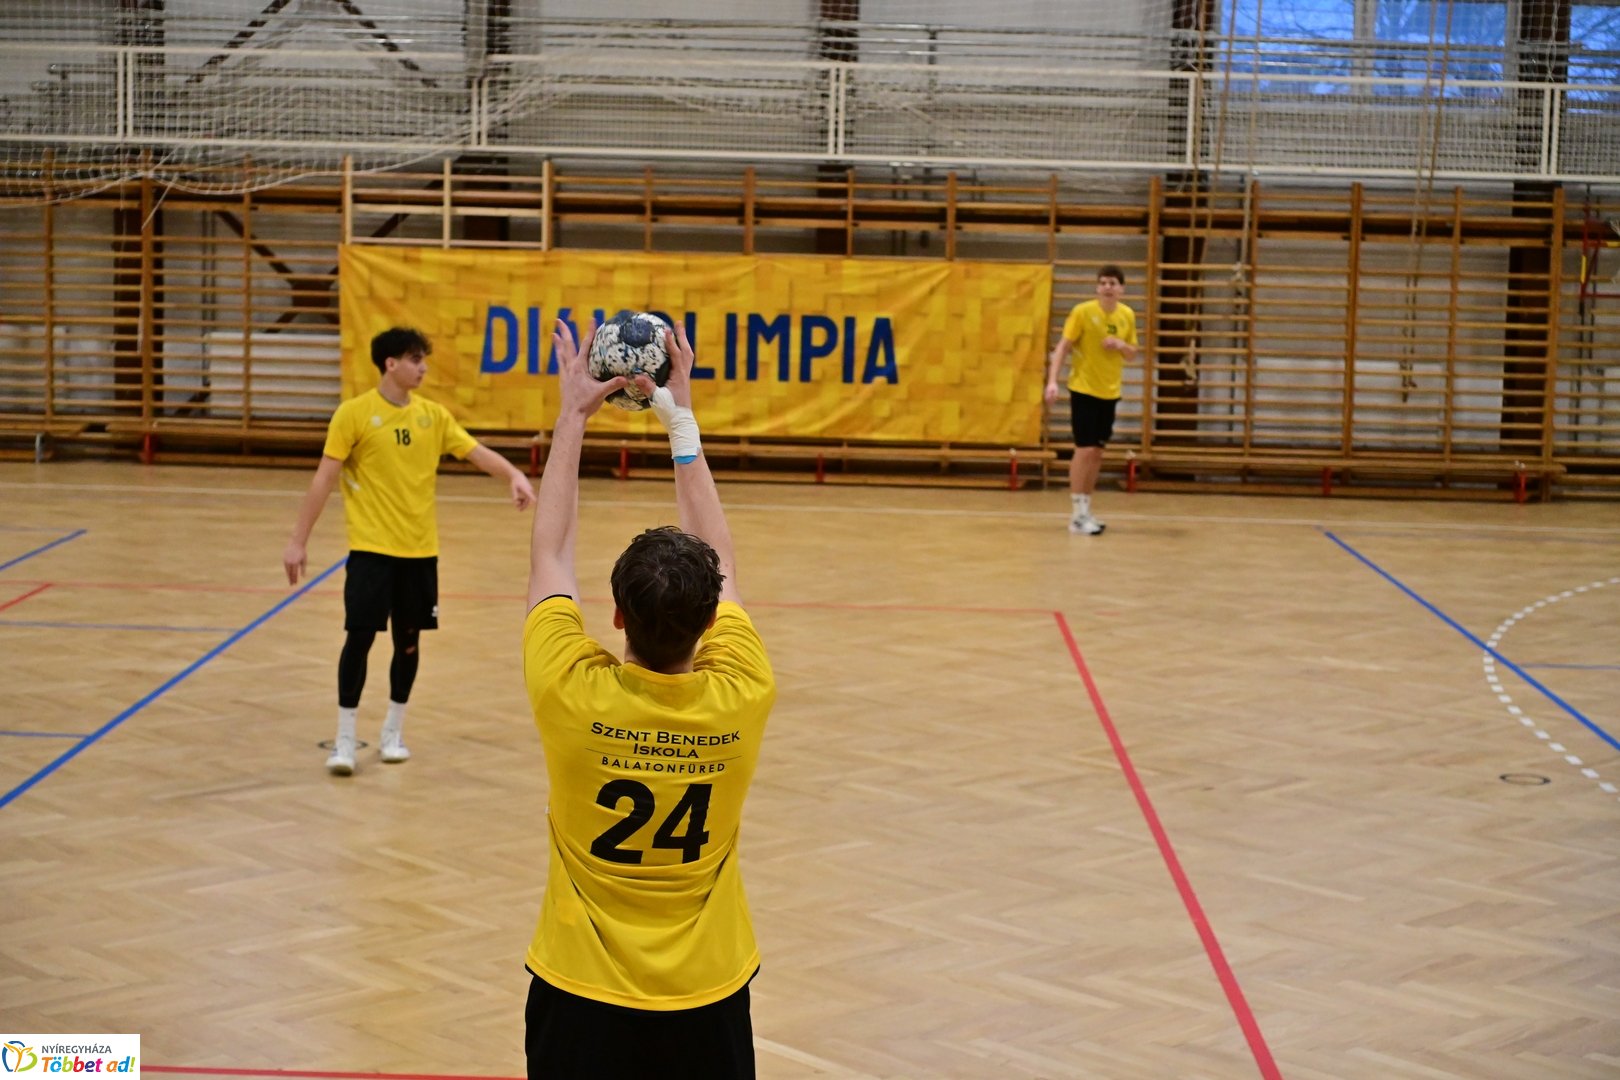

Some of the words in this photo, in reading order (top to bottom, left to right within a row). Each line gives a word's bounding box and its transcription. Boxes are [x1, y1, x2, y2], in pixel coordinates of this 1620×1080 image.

[394, 428, 412, 446] 18
[591, 722, 651, 743] SZENT
[656, 730, 741, 746] BENEDEK
[633, 743, 700, 759] ISKOLA
[601, 756, 726, 774] BALATONFÜRED
[589, 778, 713, 864] 24
